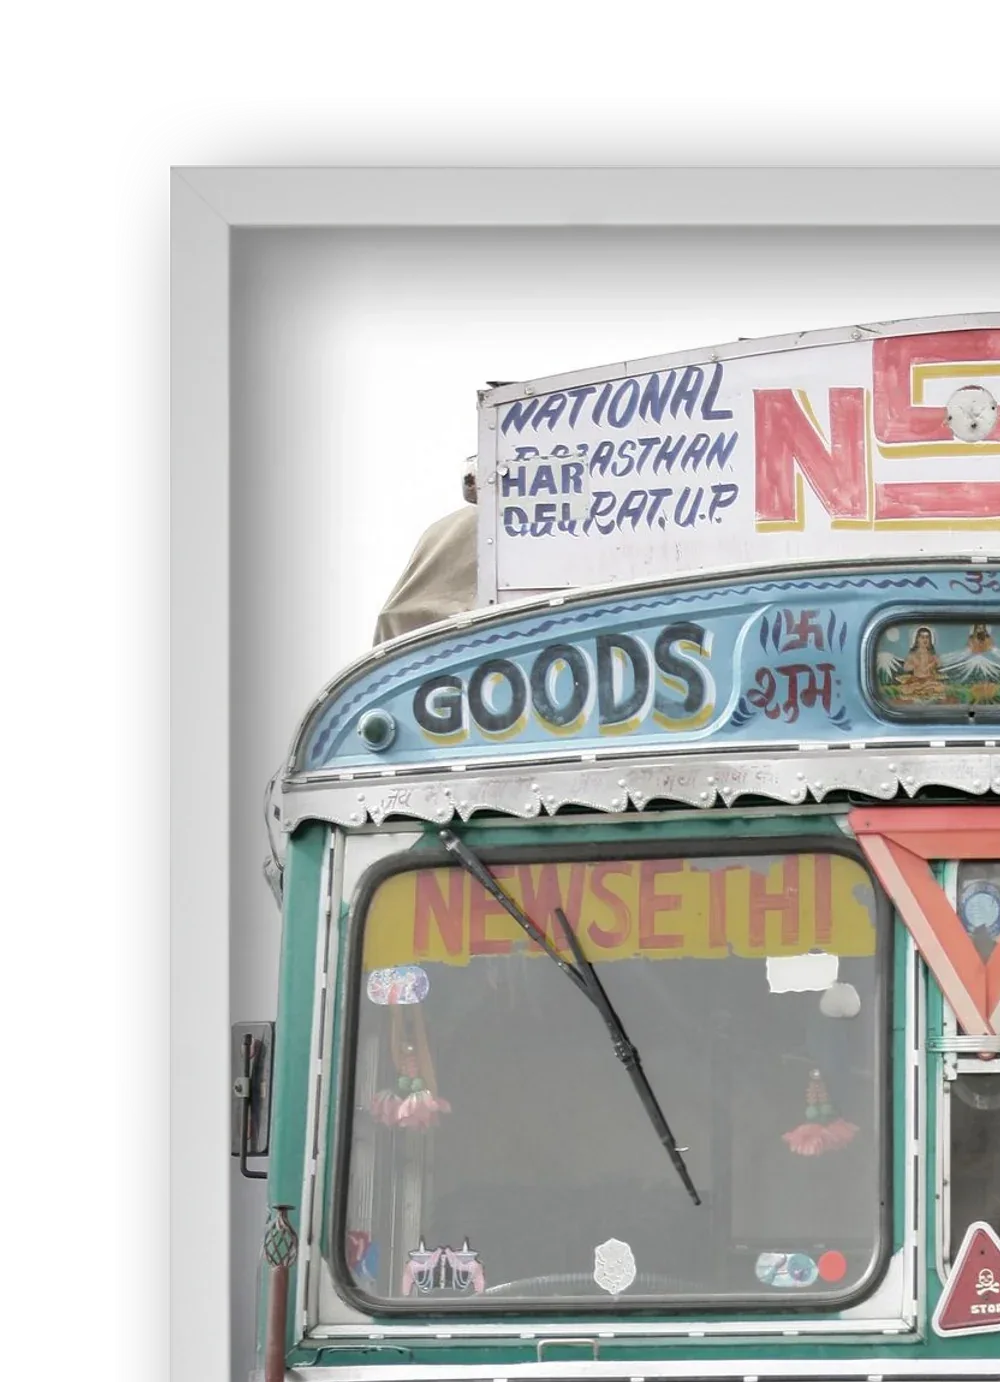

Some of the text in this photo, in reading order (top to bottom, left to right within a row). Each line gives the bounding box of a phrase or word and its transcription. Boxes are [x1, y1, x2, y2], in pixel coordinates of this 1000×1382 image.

[501, 362, 733, 436] NATIONAL
[501, 462, 585, 497] HAR
[412, 620, 716, 747] GOODS
